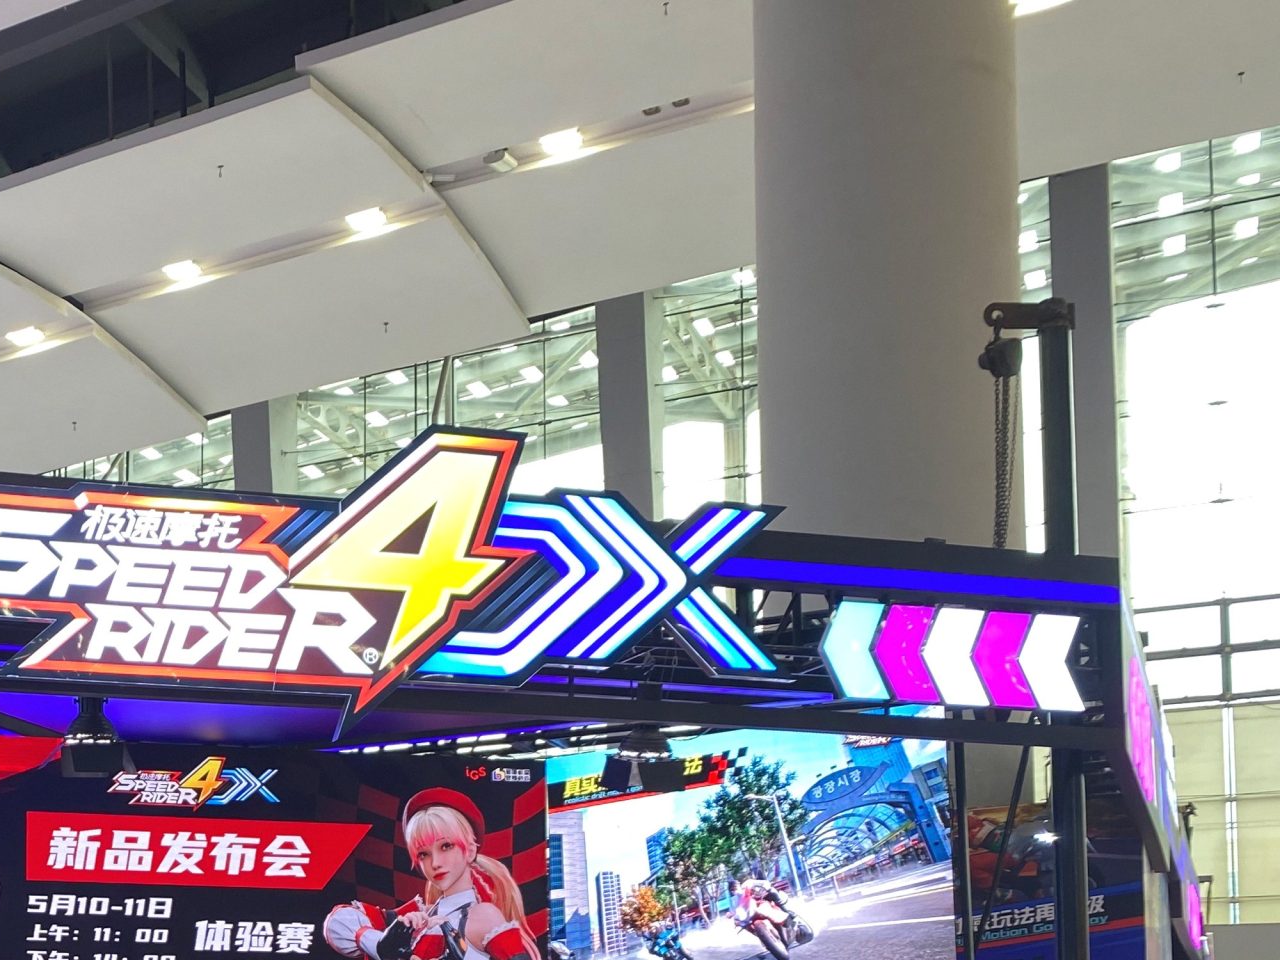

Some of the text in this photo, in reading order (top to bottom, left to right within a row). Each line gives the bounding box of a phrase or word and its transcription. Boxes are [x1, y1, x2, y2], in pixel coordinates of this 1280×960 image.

[80, 504, 243, 549] 极速摩托
[288, 450, 506, 668] 4
[84, 585, 380, 674] RIDER
[118, 773, 180, 792] SPEED
[180, 756, 226, 803] 4
[140, 787, 198, 805] RIDER
[47, 827, 312, 878] 新品发布会
[26, 894, 173, 919] 5月10-11日
[194, 920, 315, 954] 体验赛
